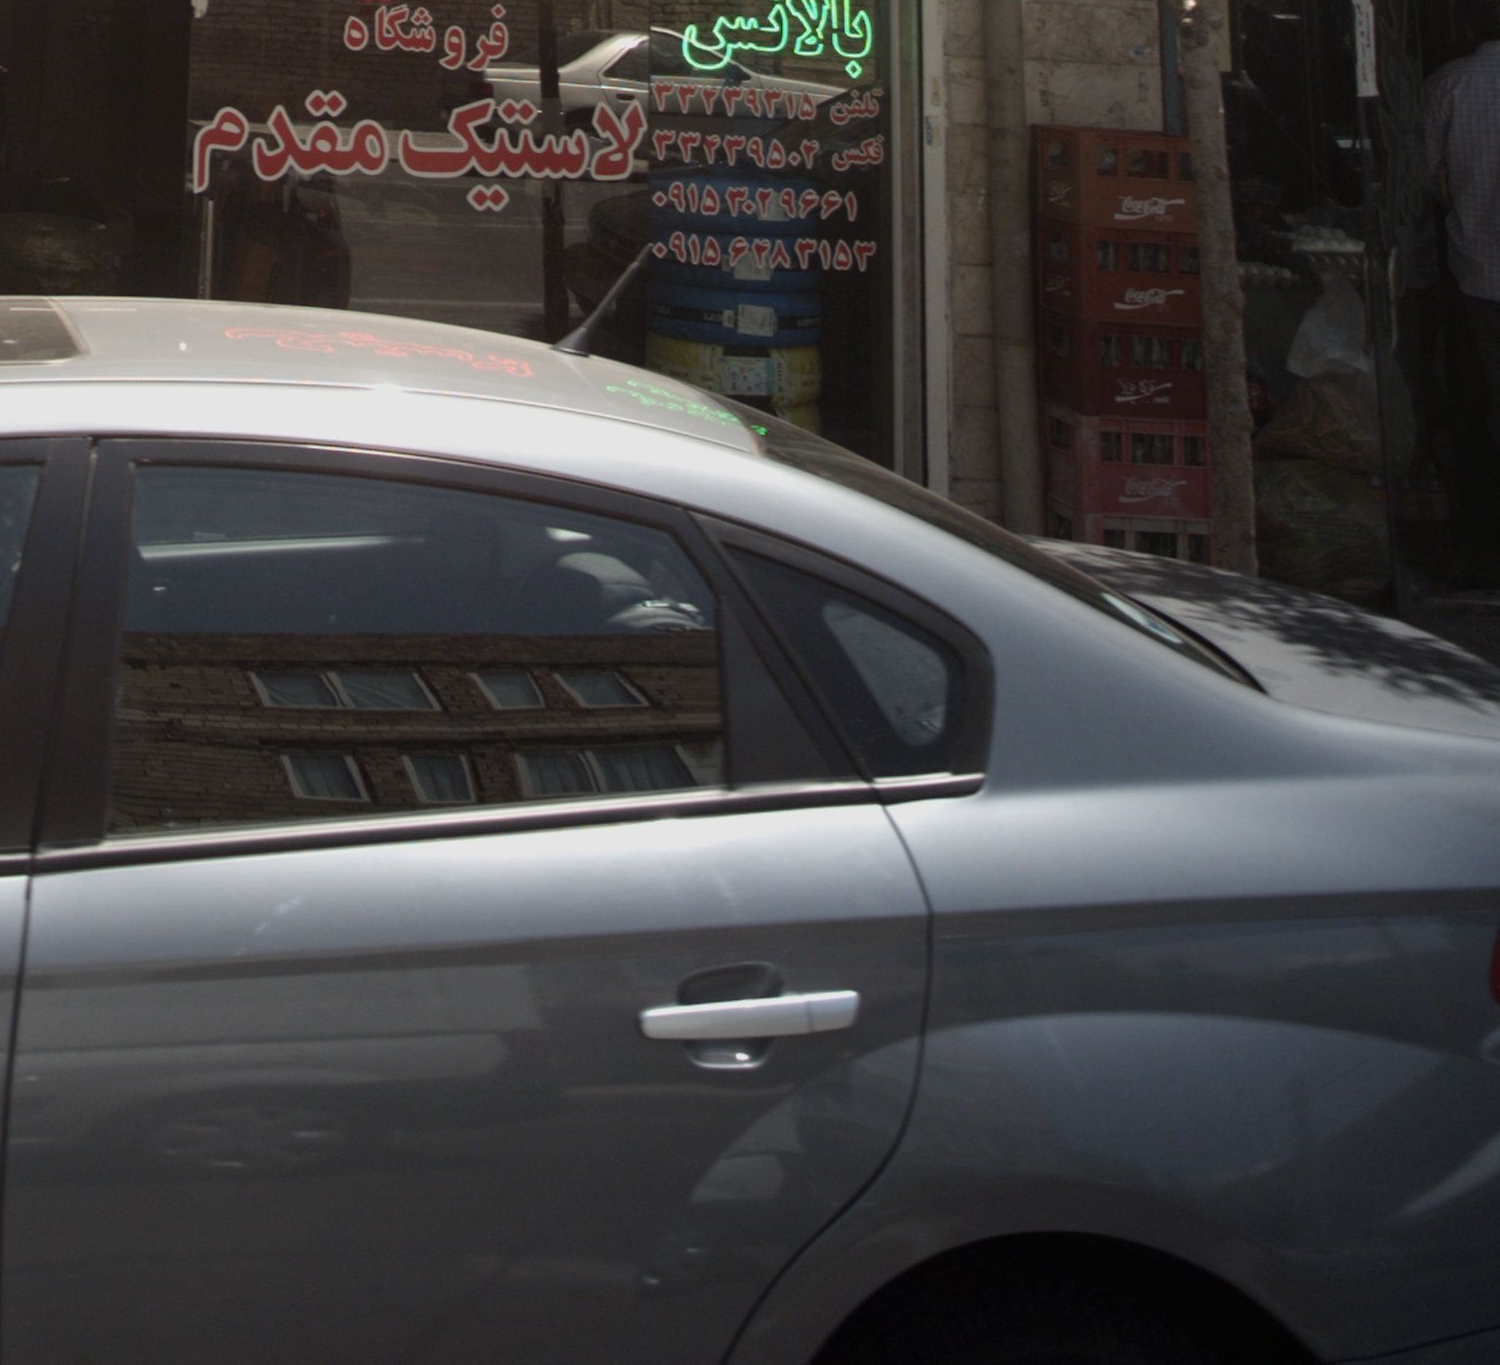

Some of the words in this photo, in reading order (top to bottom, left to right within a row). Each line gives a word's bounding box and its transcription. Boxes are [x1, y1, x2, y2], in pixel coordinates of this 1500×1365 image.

[344, 3, 510, 71] فروشگاه
[829, 87, 885, 126] تلفن
[192, 89, 390, 193] مقدم
[398, 97, 649, 212] لاستیک
[831, 134, 886, 172] فکس
